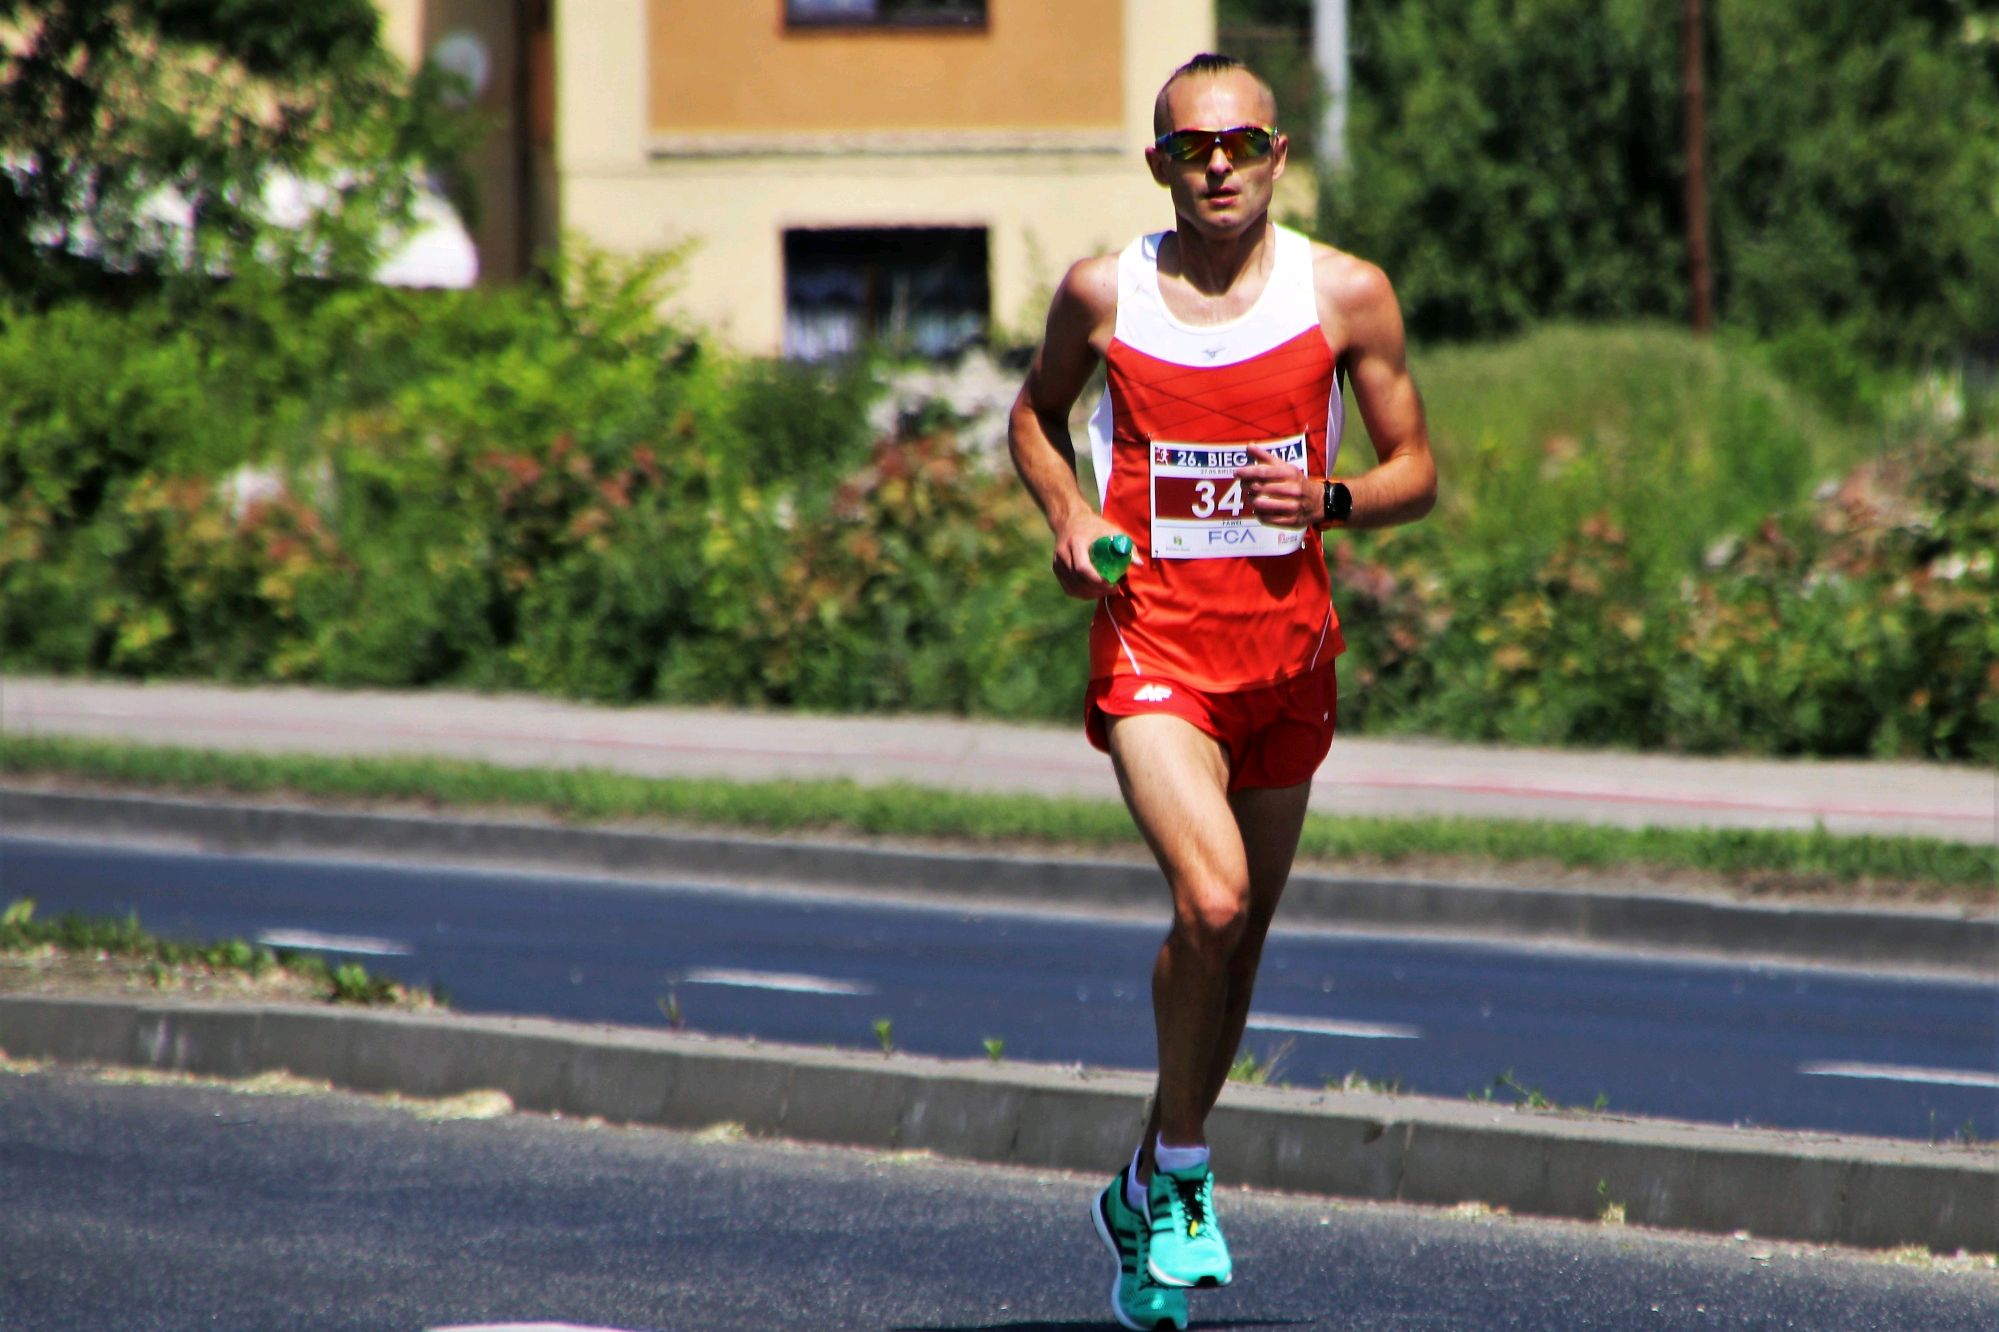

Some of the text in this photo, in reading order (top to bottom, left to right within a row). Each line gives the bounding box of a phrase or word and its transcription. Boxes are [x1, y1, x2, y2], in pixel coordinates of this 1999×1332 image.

[1177, 451, 1201, 467] 26.
[1208, 452, 1248, 467] BIEG
[1192, 480, 1254, 519] 34
[1208, 529, 1256, 544] FCA
